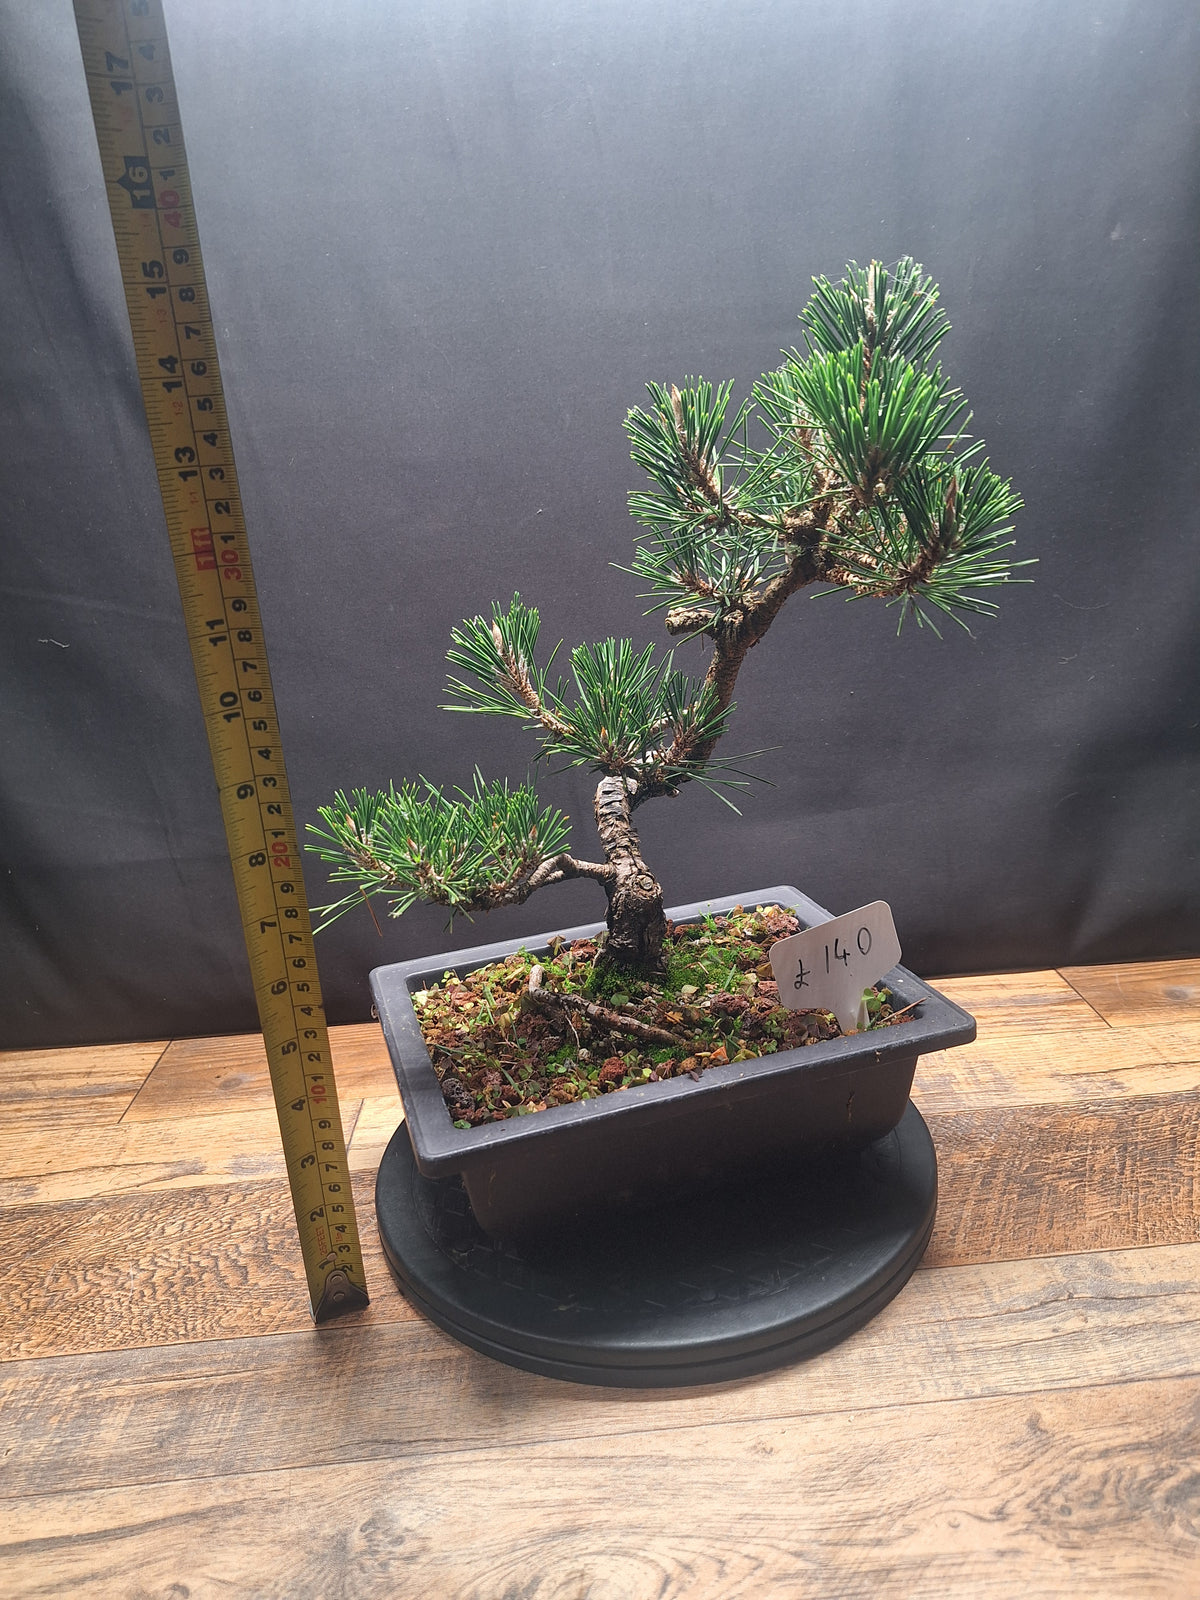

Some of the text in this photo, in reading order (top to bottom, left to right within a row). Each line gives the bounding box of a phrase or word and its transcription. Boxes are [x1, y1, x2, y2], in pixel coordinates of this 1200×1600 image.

[104, 51, 132, 95] 17
[146, 86, 164, 103] 3
[152, 128, 170, 144] 2
[160, 170, 176, 180] 1
[127, 164, 153, 203] 16
[159, 190, 182, 228] 40
[173, 248, 190, 265] 9
[142, 260, 166, 299] 15
[179, 287, 195, 302] 8
[184, 326, 200, 340] 7
[158, 355, 182, 393] 14
[191, 361, 207, 376] 6
[197, 398, 213, 412] 5
[203, 432, 218, 447] 4
[174, 446, 198, 482] 13
[209, 467, 224, 480] 3
[215, 501, 230, 514] 2
[220, 535, 235, 544] 1
[222, 550, 242, 580] 30
[232, 599, 247, 612] 9
[206, 619, 227, 647] 11
[238, 630, 252, 642] 8
[242, 661, 257, 672] 7
[248, 690, 262, 702] 6
[220, 691, 240, 723] 10
[253, 720, 268, 731] 5
[258, 748, 272, 760] 4
[263, 777, 277, 787] 3
[237, 784, 254, 800] 9
[267, 804, 282, 815] 2
[248, 852, 266, 868] 8
[272, 842, 290, 868] 20
[280, 882, 294, 894] 9
[284, 908, 298, 918] 8
[260, 921, 277, 934] 7
[288, 934, 302, 944] 7
[292, 958, 306, 968] 6
[271, 980, 288, 995] 6
[297, 983, 310, 992] 5
[300, 1006, 314, 1016] 4
[304, 1030, 318, 1039] 3
[282, 1041, 298, 1056] 5
[308, 1053, 320, 1062] 2
[310, 1084, 328, 1104] 10
[291, 1099, 306, 1112] 4
[318, 1120, 332, 1130] 9
[322, 1142, 334, 1150] 8
[300, 1154, 316, 1168] 3
[326, 1164, 338, 1172] 7
[328, 1184, 342, 1192] 6
[332, 1204, 344, 1212] 5
[310, 1208, 324, 1222] 2
[335, 1224, 347, 1234] 4
[338, 1245, 350, 1253] 3
